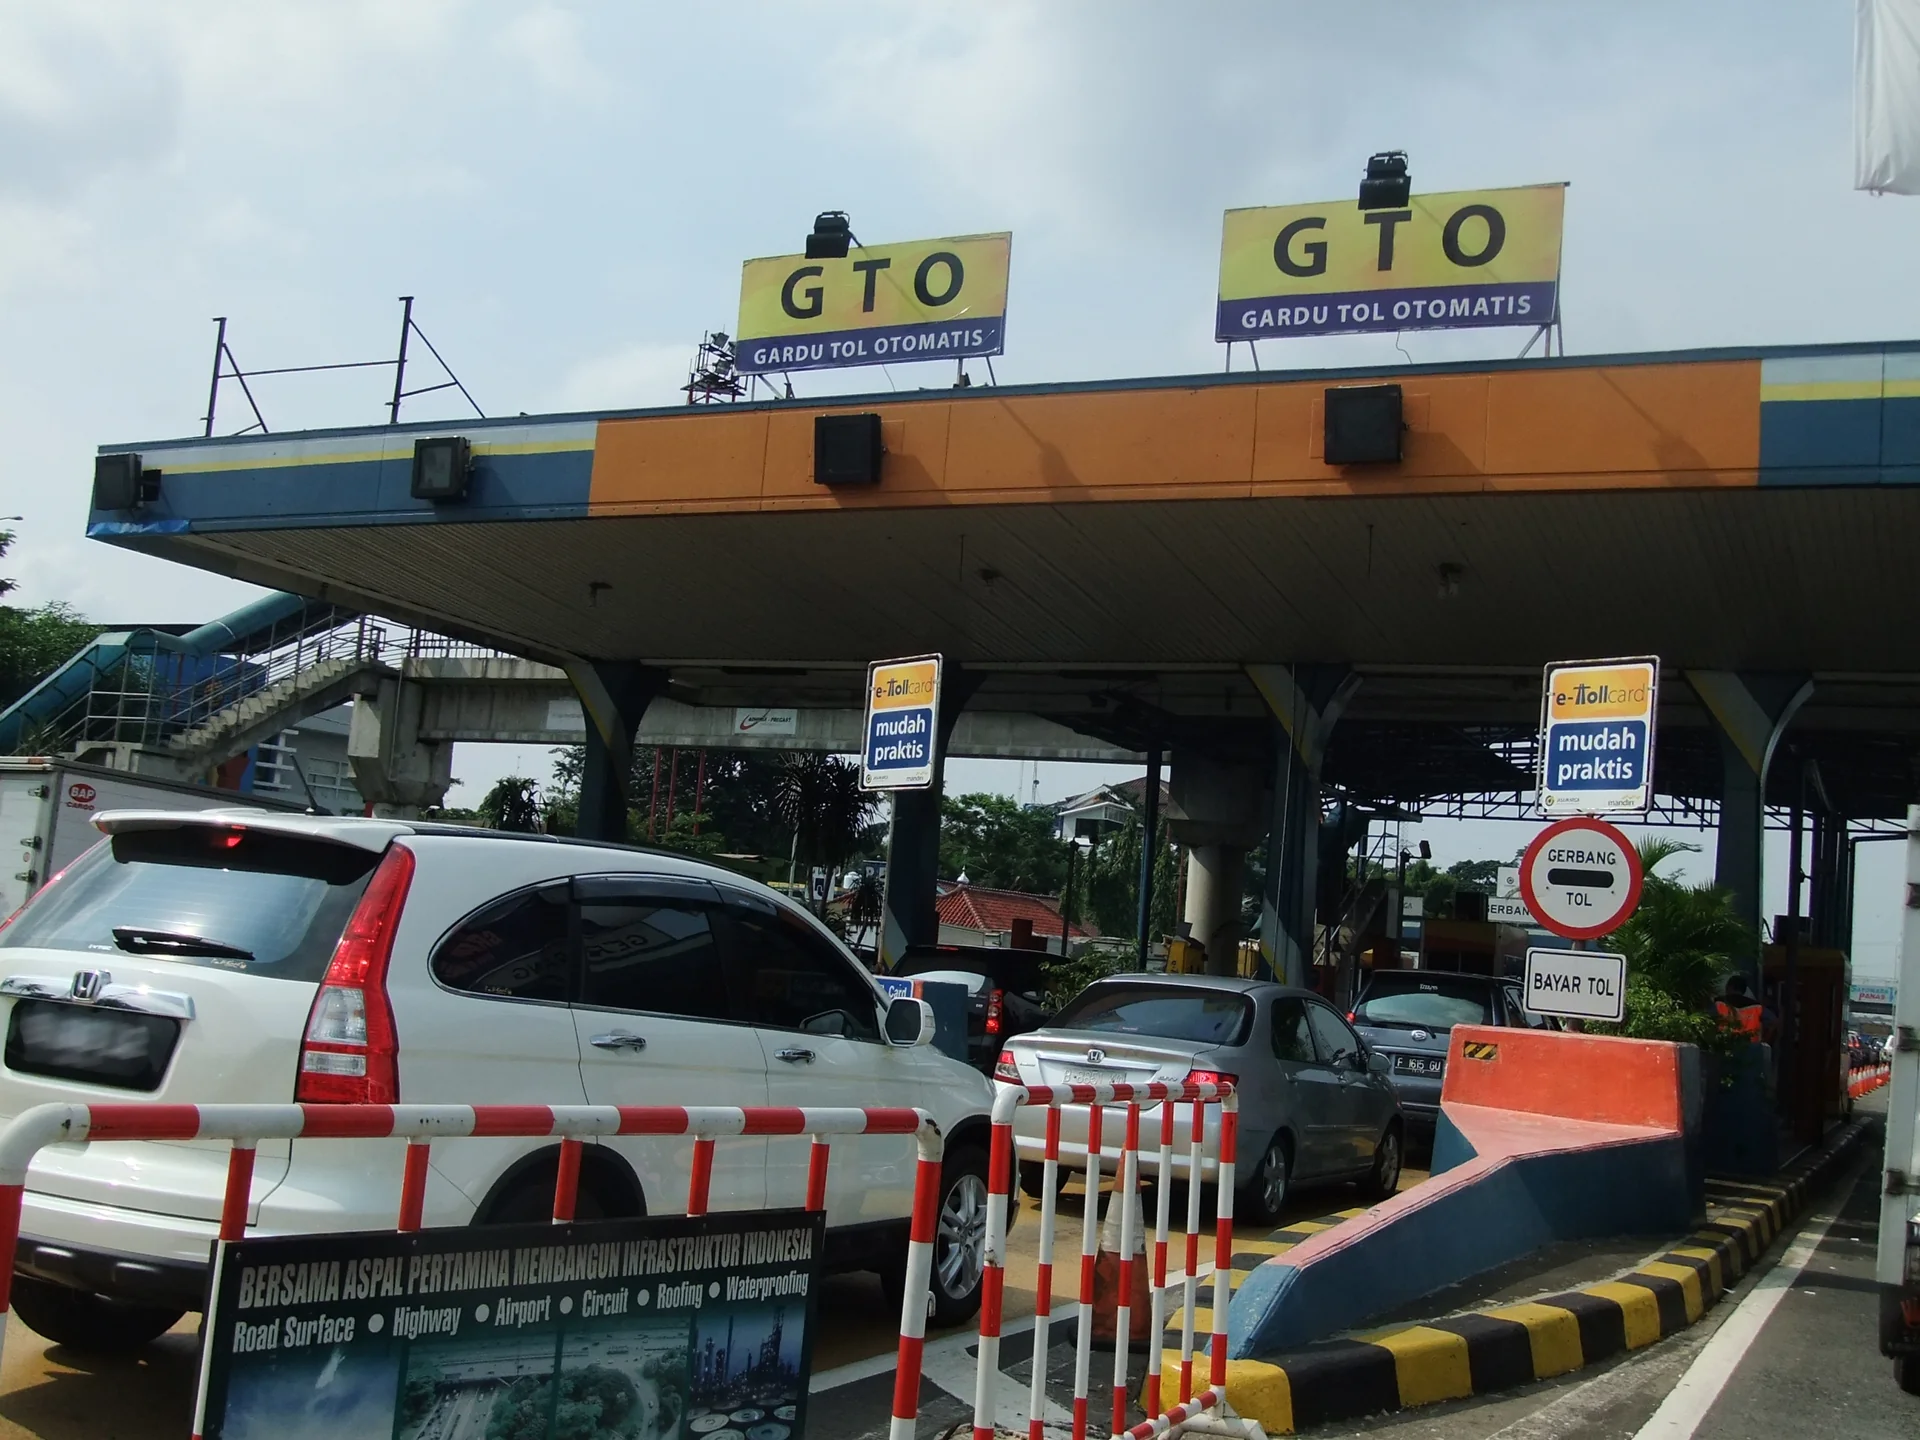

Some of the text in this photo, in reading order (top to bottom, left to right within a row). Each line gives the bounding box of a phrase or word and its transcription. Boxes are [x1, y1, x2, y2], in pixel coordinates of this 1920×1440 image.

[1241, 295, 1532, 328] GARDU TOL OTOMATIS
[754, 329, 983, 365] GARDU TOL OTOMATIS
[876, 714, 926, 736] mudah
[1558, 726, 1636, 752] mudah
[874, 740, 923, 766] praktis
[1557, 757, 1633, 786] praktis
[1547, 849, 1616, 865] GERBANG
[1566, 892, 1592, 907] TOL
[1533, 973, 1614, 996] BAYAR TOL
[1397, 1057, 1441, 1071] F 1615 GU
[238, 1227, 813, 1309] BERSAMA ASPAL PERTAMINA MEMBANGUN INFRASTRUKTUR INDONESIA
[233, 1270, 810, 1353] Road Surface Highway Airport Circuit Roofing Waterproofing
